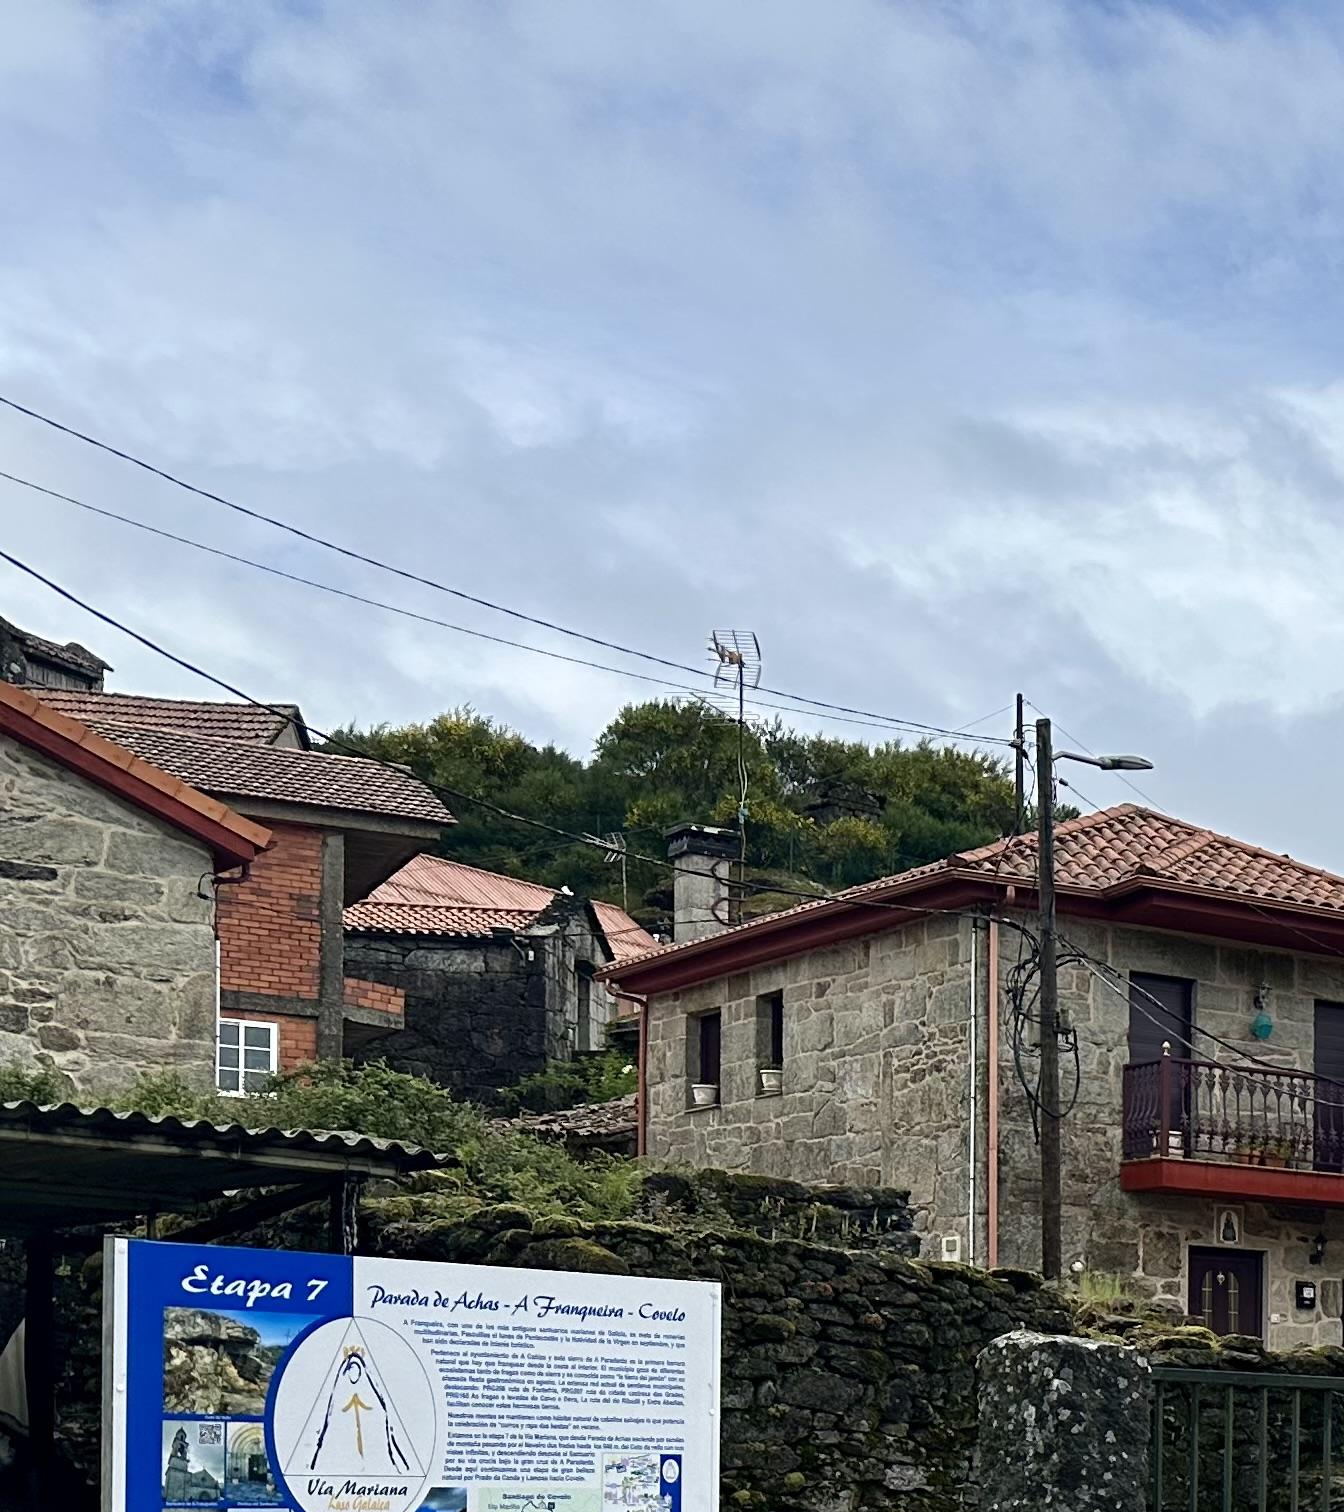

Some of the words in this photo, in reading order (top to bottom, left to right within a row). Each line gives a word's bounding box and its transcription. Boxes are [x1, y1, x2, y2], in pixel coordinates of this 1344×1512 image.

[181, 1265, 292, 1307] Etapa
[307, 1279, 328, 1300] 7
[367, 1285, 428, 1308] Parada
[433, 1291, 449, 1308] de
[450, 1291, 499, 1312] Achas
[511, 1295, 528, 1316] A
[534, 1296, 624, 1322] Franqueira
[639, 1303, 685, 1322] Covelo
[335, 1480, 408, 1499] Mariana
